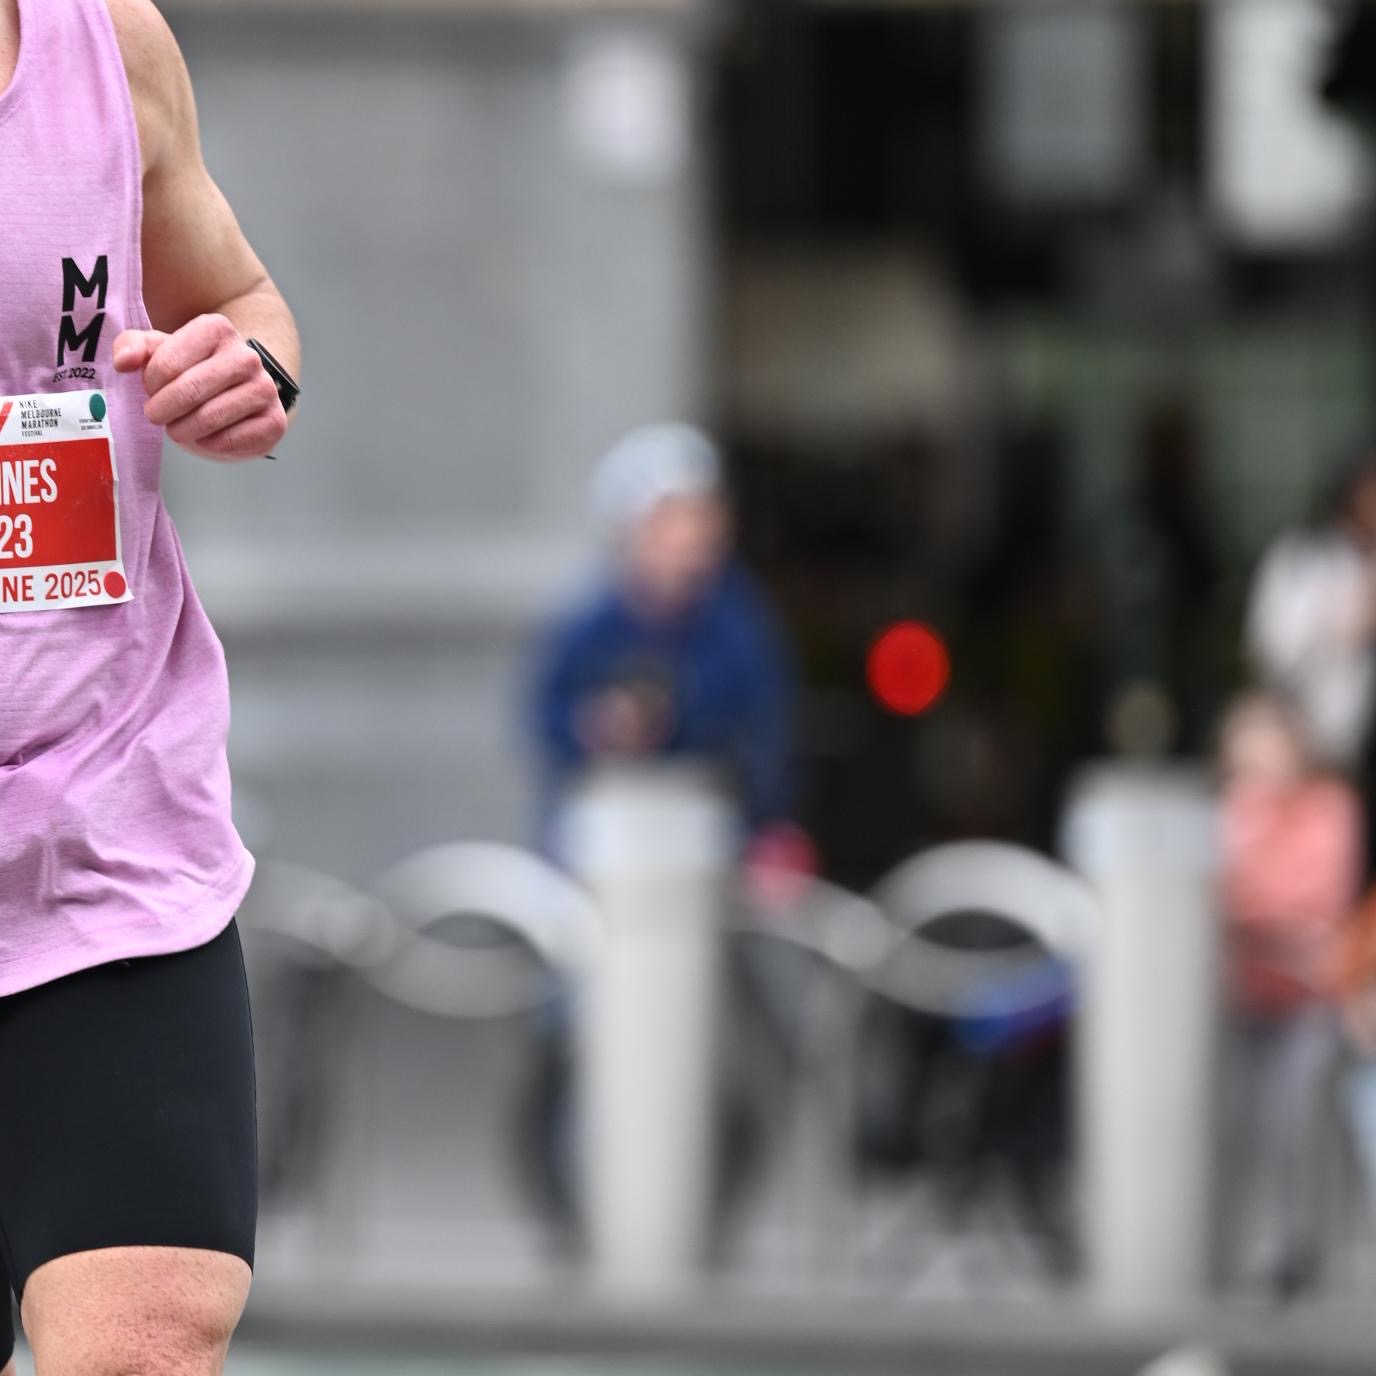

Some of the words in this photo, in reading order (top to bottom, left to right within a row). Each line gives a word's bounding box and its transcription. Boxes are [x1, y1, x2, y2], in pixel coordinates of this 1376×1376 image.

[68, 367, 97, 380] 2022
[19, 400, 38, 409] NIKE
[21, 408, 62, 419] MELBOURNE
[21, 419, 59, 430] MARATHON
[21, 430, 43, 438] FESTIVAL
[44, 569, 102, 601] 2025
